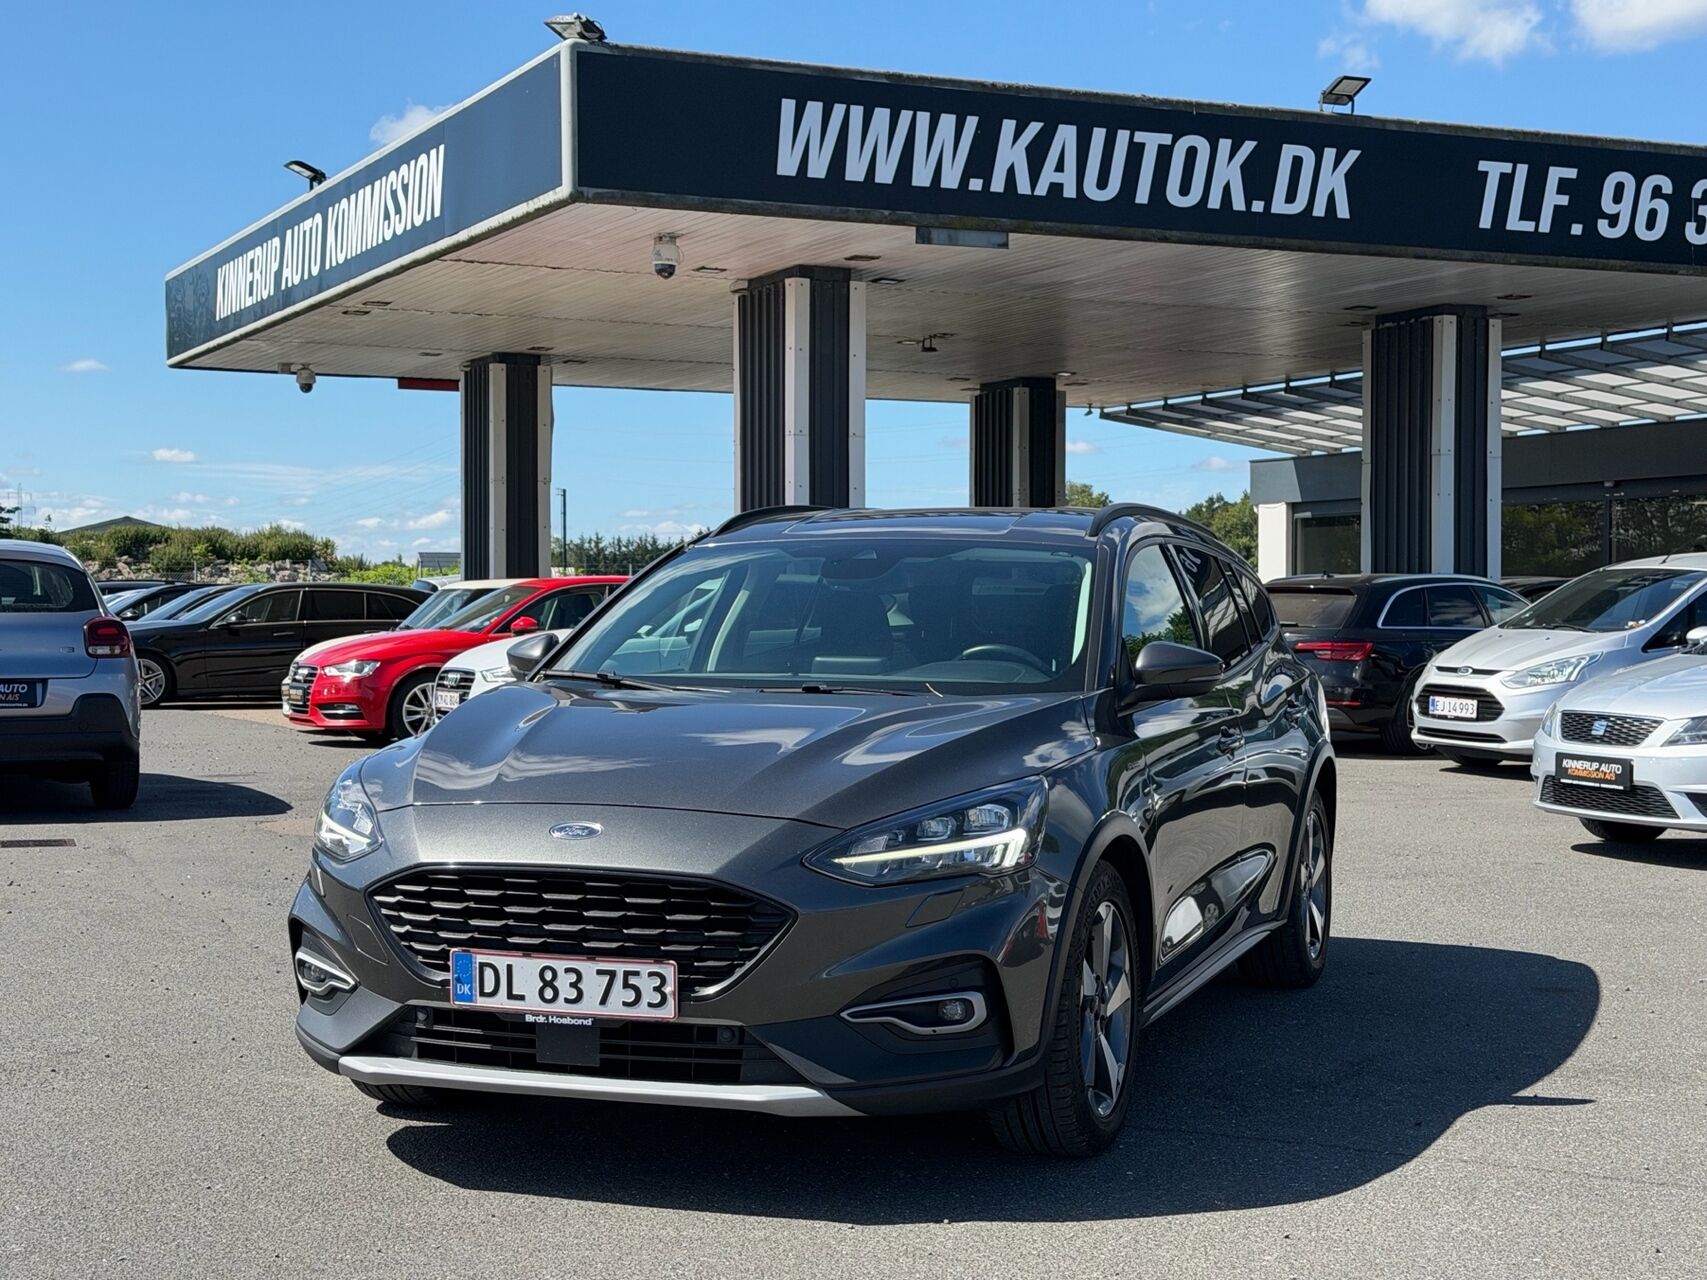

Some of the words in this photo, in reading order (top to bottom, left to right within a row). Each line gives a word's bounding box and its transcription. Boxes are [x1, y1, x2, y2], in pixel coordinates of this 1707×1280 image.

[776, 98, 1362, 219] WWW.KAUTOK.DK
[1477, 160, 1583, 236] TLF.
[1597, 171, 1673, 242] 96
[216, 236, 281, 322] KINNERUP
[281, 212, 323, 290] AUTO
[325, 144, 445, 270] KOMMISSION
[1459, 702, 1475, 715] 993
[1562, 758, 1600, 771] KINNERUP
[1600, 763, 1622, 774] AUTO
[1568, 767, 1604, 779] KOMMISSION
[457, 983, 472, 996] DK
[478, 961, 526, 1001] DL
[538, 965, 584, 1004] 83
[596, 969, 668, 1009] 753
[525, 1014, 547, 1023] Brdr.
